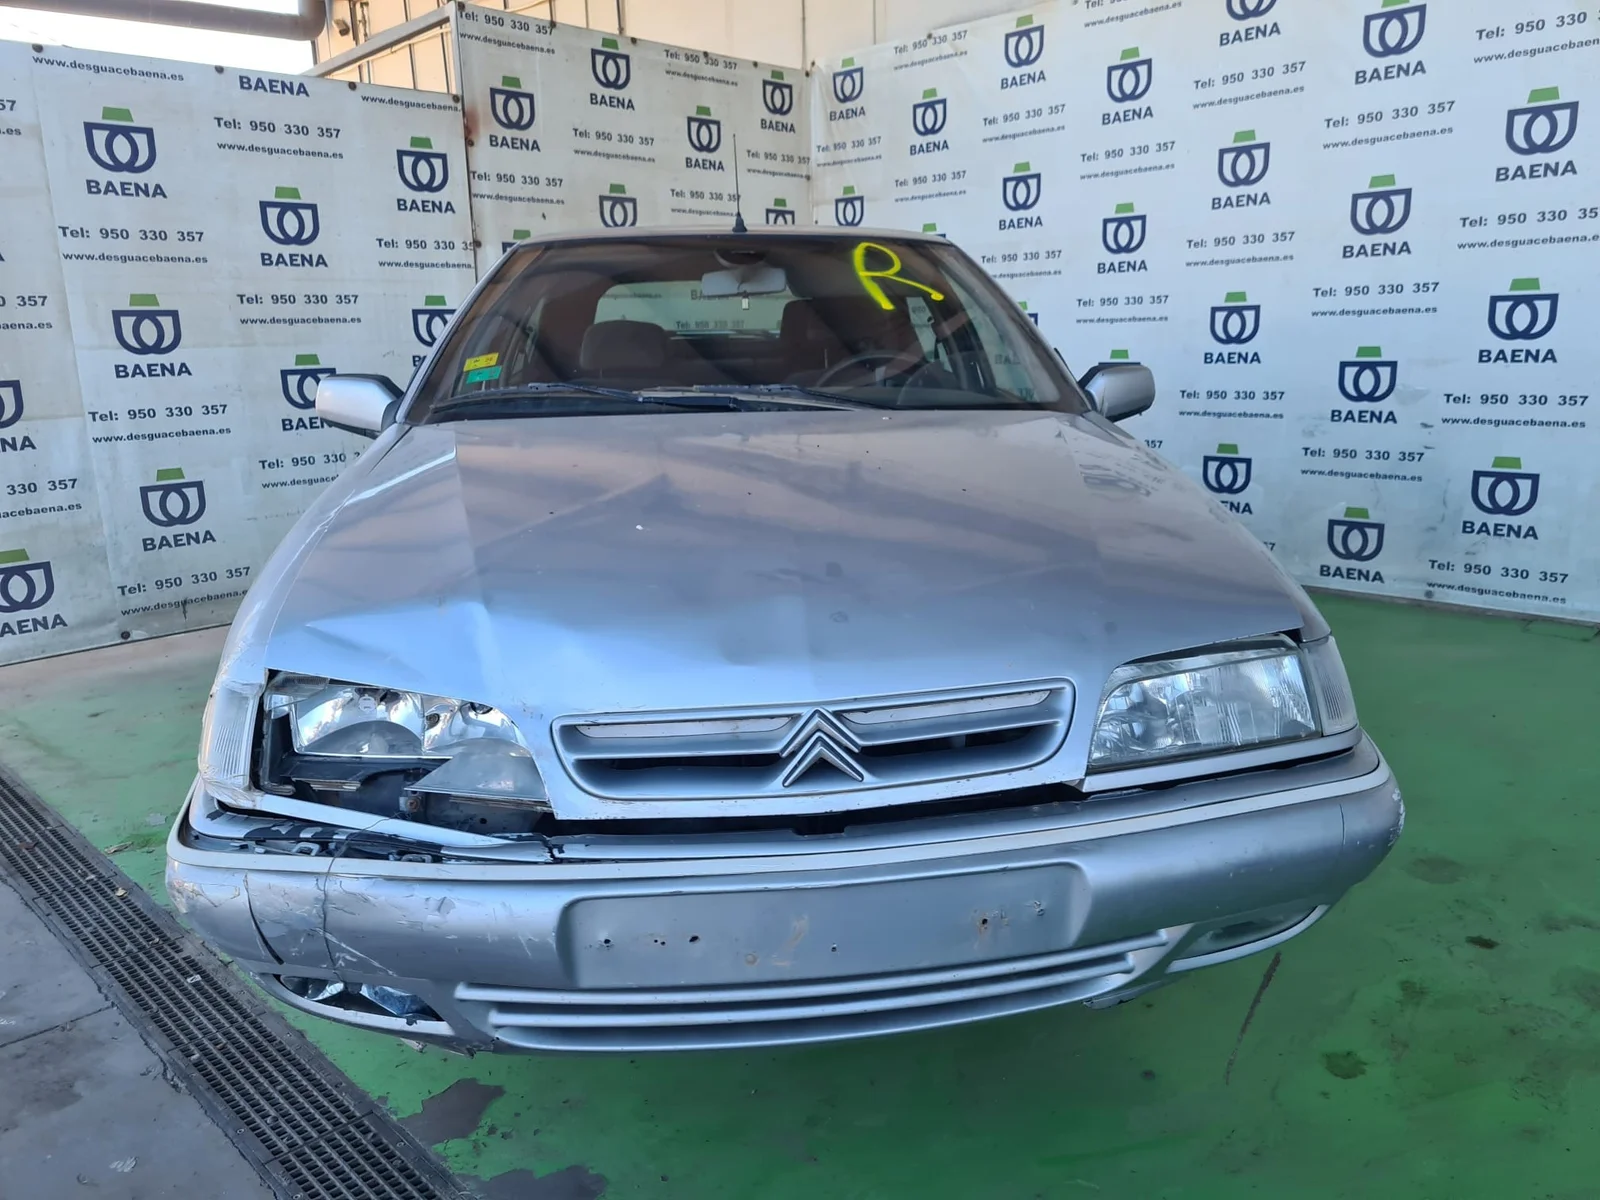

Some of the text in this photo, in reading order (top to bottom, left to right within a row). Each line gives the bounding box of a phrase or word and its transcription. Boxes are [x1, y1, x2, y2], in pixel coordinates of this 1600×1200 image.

[459, 10, 554, 35] Tel: 950 330 357
[1084, 1, 1181, 27] www.desguacebaena.es
[1219, 22, 1280, 46] BAENA
[1476, 11, 1586, 40] Tel: 950 330
[894, 29, 967, 54] Tel: 950 330 357
[663, 49, 737, 69] Tel: 950 330 357
[32, 56, 183, 80] www.desguacebaena.es
[1194, 60, 1305, 89] Tel: 950 330 357
[1355, 60, 1425, 84] BAENA
[239, 75, 309, 96] BAENA
[1001, 70, 1045, 89] BAENA
[590, 92, 634, 110] BAENA
[1192, 86, 1304, 109] www.desguacebaena.es
[829, 106, 865, 121] BAENA
[983, 103, 1065, 126] Tel: 950 330 357
[1102, 106, 1153, 125] BAENA
[1324, 100, 1455, 128] Tel: 950 330 357
[214, 116, 340, 138] Tel: 950 330 357
[760, 118, 795, 133] BAENA
[489, 134, 540, 151] BAENA
[572, 127, 654, 145] Tel: 950 330 357
[1322, 127, 1452, 149] www.desguacebaena.es
[217, 143, 343, 158] www.desguacebaena.es
[910, 139, 948, 155] BAENA
[1080, 140, 1175, 162] Tel: 950 330 357
[685, 157, 724, 171] BAENA
[1080, 163, 1174, 179] www.desguacebaena.es
[1495, 160, 1577, 181] BAENA
[470, 170, 562, 187] Tel: 950 330 357
[895, 170, 966, 187] Tel: 950 330 357
[86, 179, 167, 198] BAENA
[396, 198, 455, 213] BAENA
[1212, 192, 1270, 209] BAENA
[999, 216, 1042, 230] BAENA
[1460, 209, 1567, 227] Tel: 950 330
[58, 226, 203, 241] Tel: 950 330 357
[1186, 231, 1294, 248] Tel: 950 330 357
[376, 238, 454, 250] Tel: 950 330
[1342, 241, 1411, 258] BAENA
[62, 252, 207, 263] www.desguacebaena.es
[260, 252, 327, 267] BAENA
[981, 249, 1061, 263] Tel: 950 330 357
[1185, 255, 1293, 266] www.desguacebaena.es
[1097, 260, 1147, 273] BAENA
[853, 242, 944, 310] R
[1313, 282, 1439, 297] Tel: 950 330 357
[16, 295, 47, 306] 357
[236, 294, 358, 304] Tel: 950 330 357
[1076, 295, 1168, 306] Tel: 950 330 357
[240, 316, 361, 325] www.desguacebaena.es
[1076, 316, 1168, 324] www.desguacebaena.es
[1311, 307, 1436, 317] www.desguacebaena.es
[1204, 352, 1260, 363] BAENA
[1478, 349, 1556, 362] BAENA
[114, 362, 192, 378] BAENA
[1179, 390, 1284, 400] Tel: 950 330 357
[1443, 393, 1588, 406] Tel: 950 330 357
[88, 404, 227, 421] Tel: 950 330 357
[1179, 410, 1283, 418] www.desguacebaena.es
[1330, 409, 1396, 423] BAENA
[1441, 417, 1585, 427] www.desguacebaena.es
[92, 428, 231, 442] www.desguacebaena.es
[258, 452, 346, 469] Tel: 950 330
[1302, 447, 1424, 462] Tel: 950 330 357
[1301, 469, 1422, 481] www.desguacebaena.es
[6, 478, 77, 495] 330 357
[1462, 520, 1538, 539] BAENA
[142, 530, 216, 551] BAENA
[1320, 564, 1384, 583] BAENA
[1428, 559, 1568, 583] Tel: 950 330 357
[117, 566, 249, 596] Tel: 950 330 357
[1426, 581, 1565, 604] www.desguacebaena.es
